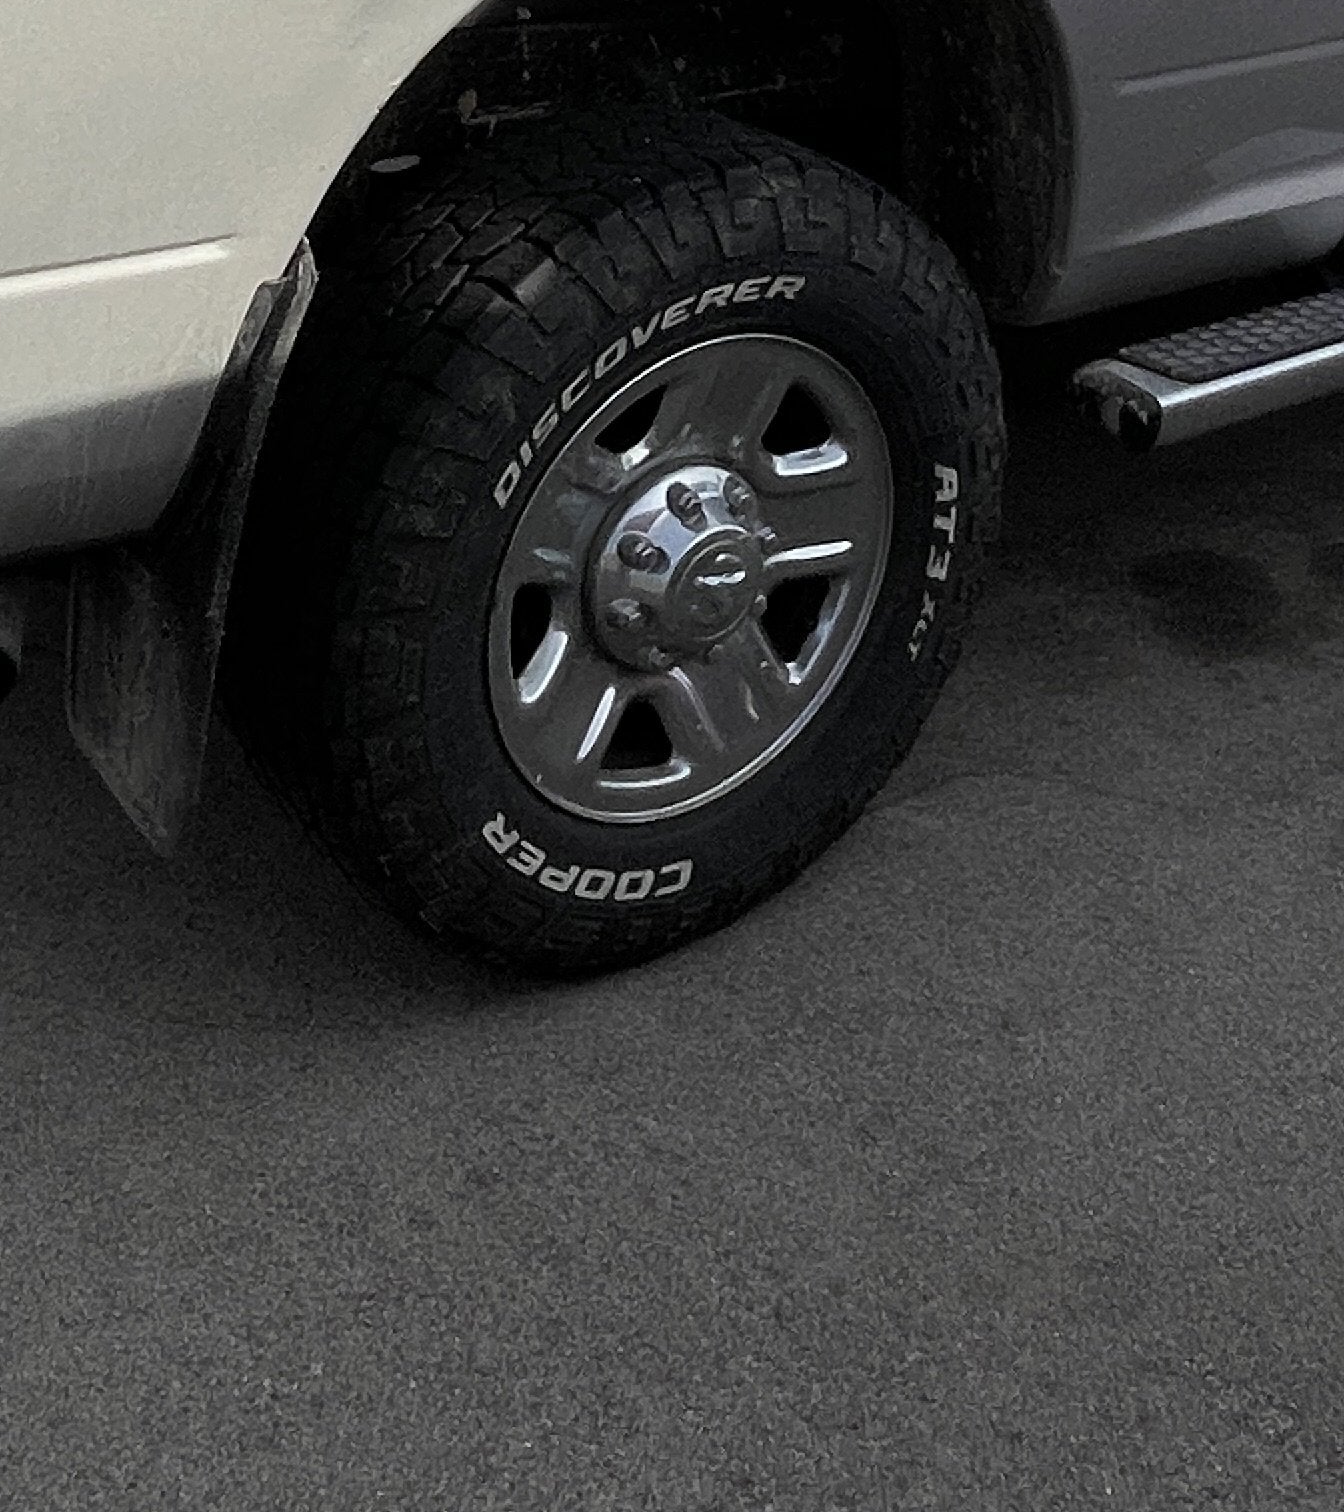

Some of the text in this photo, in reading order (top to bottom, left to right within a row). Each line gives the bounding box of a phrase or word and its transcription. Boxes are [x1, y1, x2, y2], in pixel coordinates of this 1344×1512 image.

[493, 275, 805, 508] DISCOVERER
[926, 464, 957, 581] AT3
[482, 813, 693, 900] COOPER
